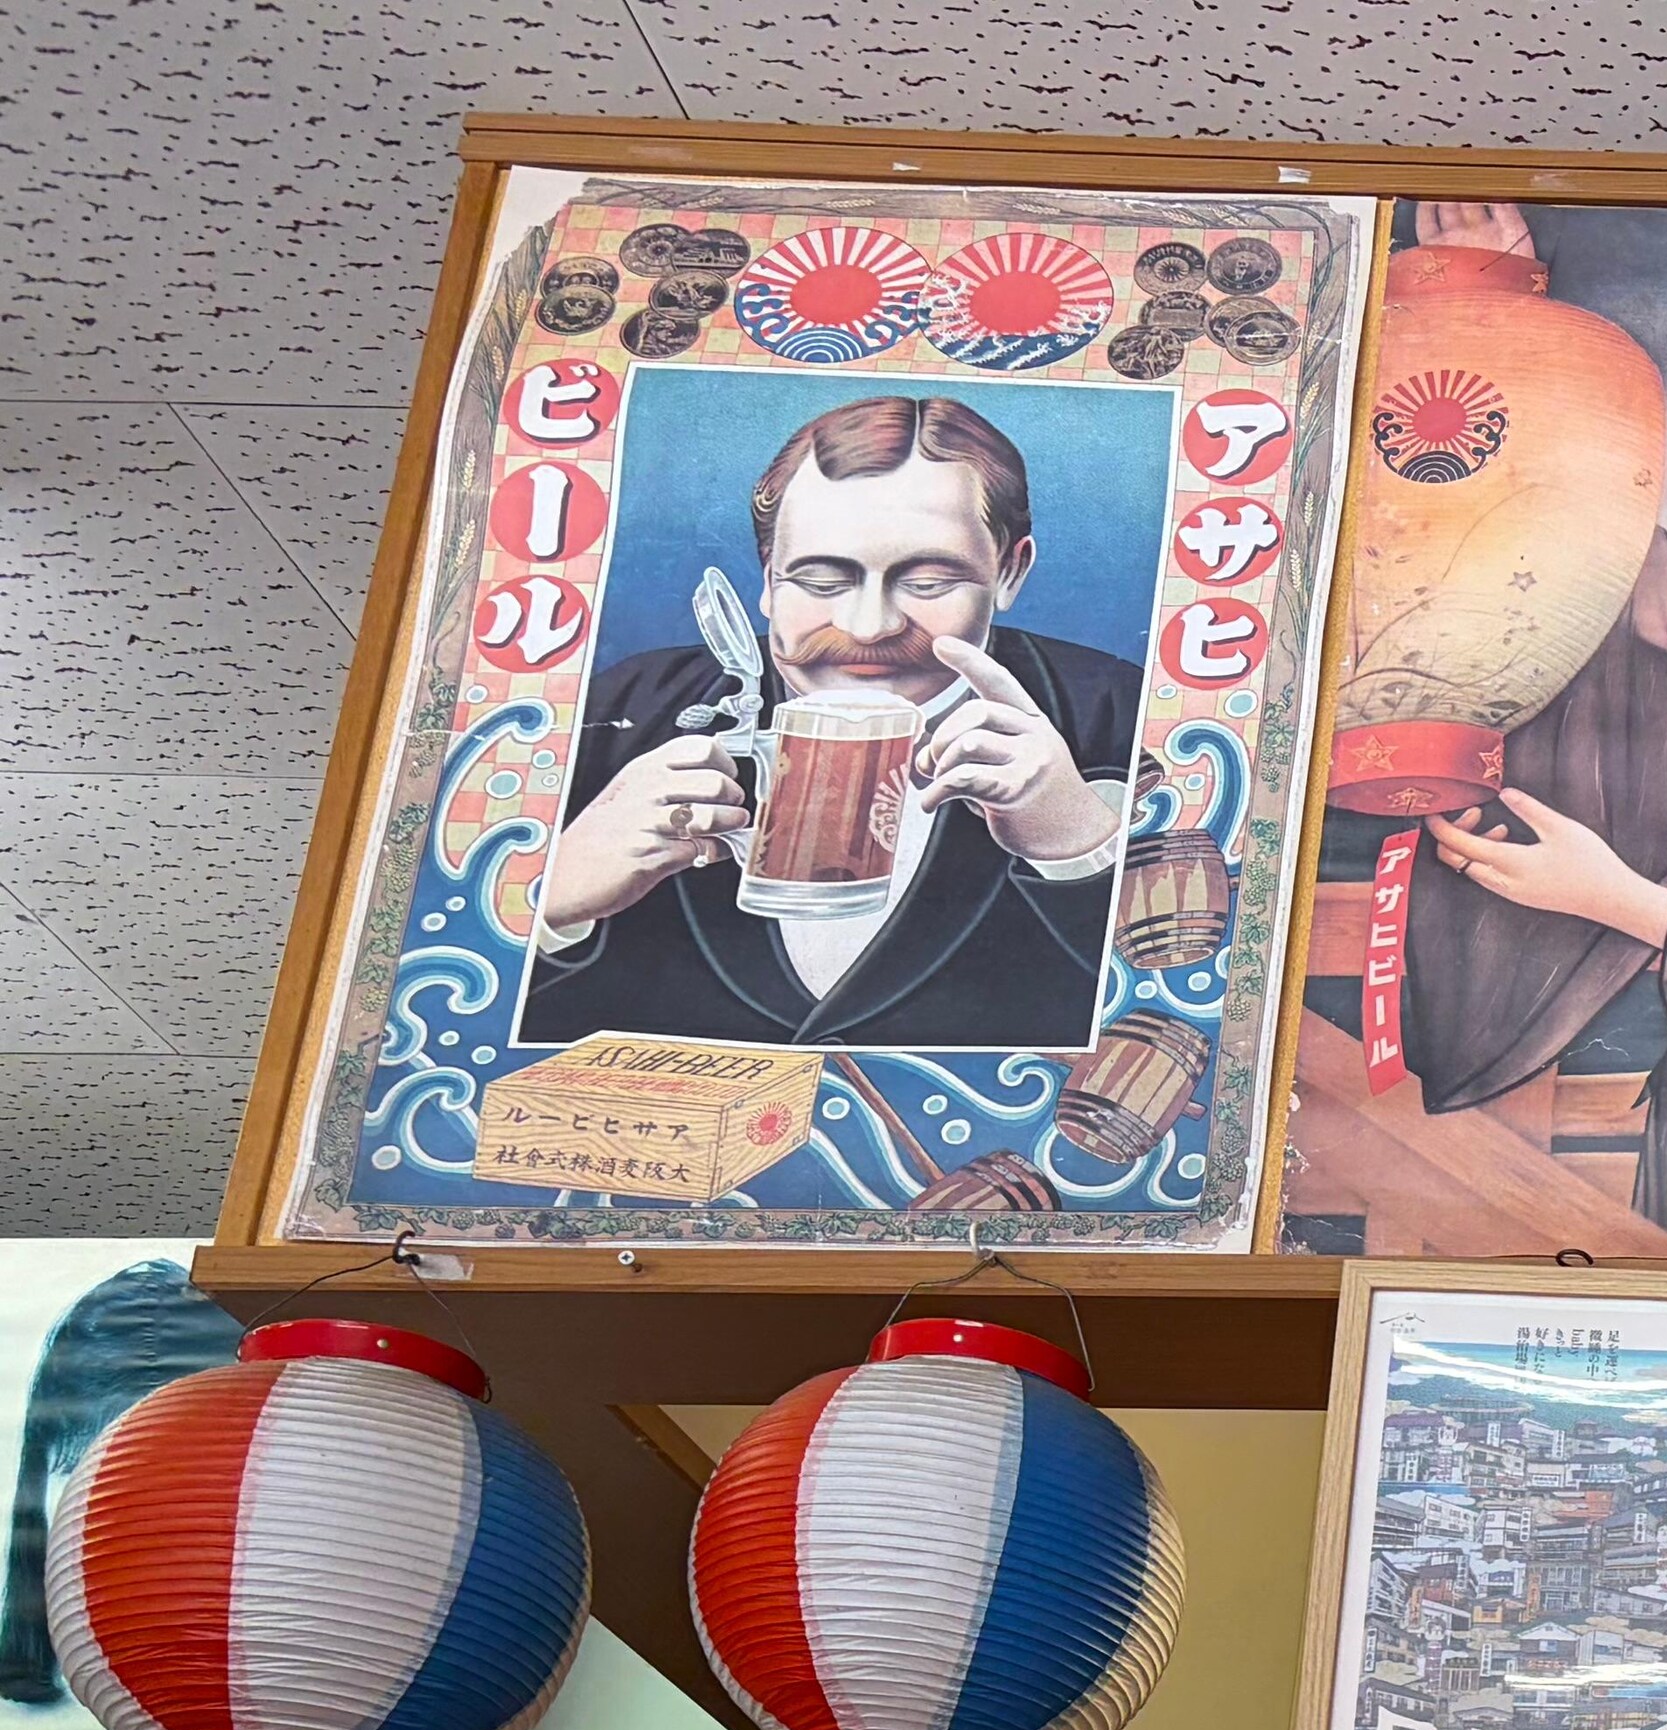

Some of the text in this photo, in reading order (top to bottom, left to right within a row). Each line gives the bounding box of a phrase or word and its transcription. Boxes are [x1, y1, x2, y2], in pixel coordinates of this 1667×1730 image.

[485, 361, 602, 665] ビール
[1173, 398, 1292, 680] アサヒ
[1367, 842, 1416, 1065] アサヒビール
[503, 1106, 690, 1141] アサヒビール
